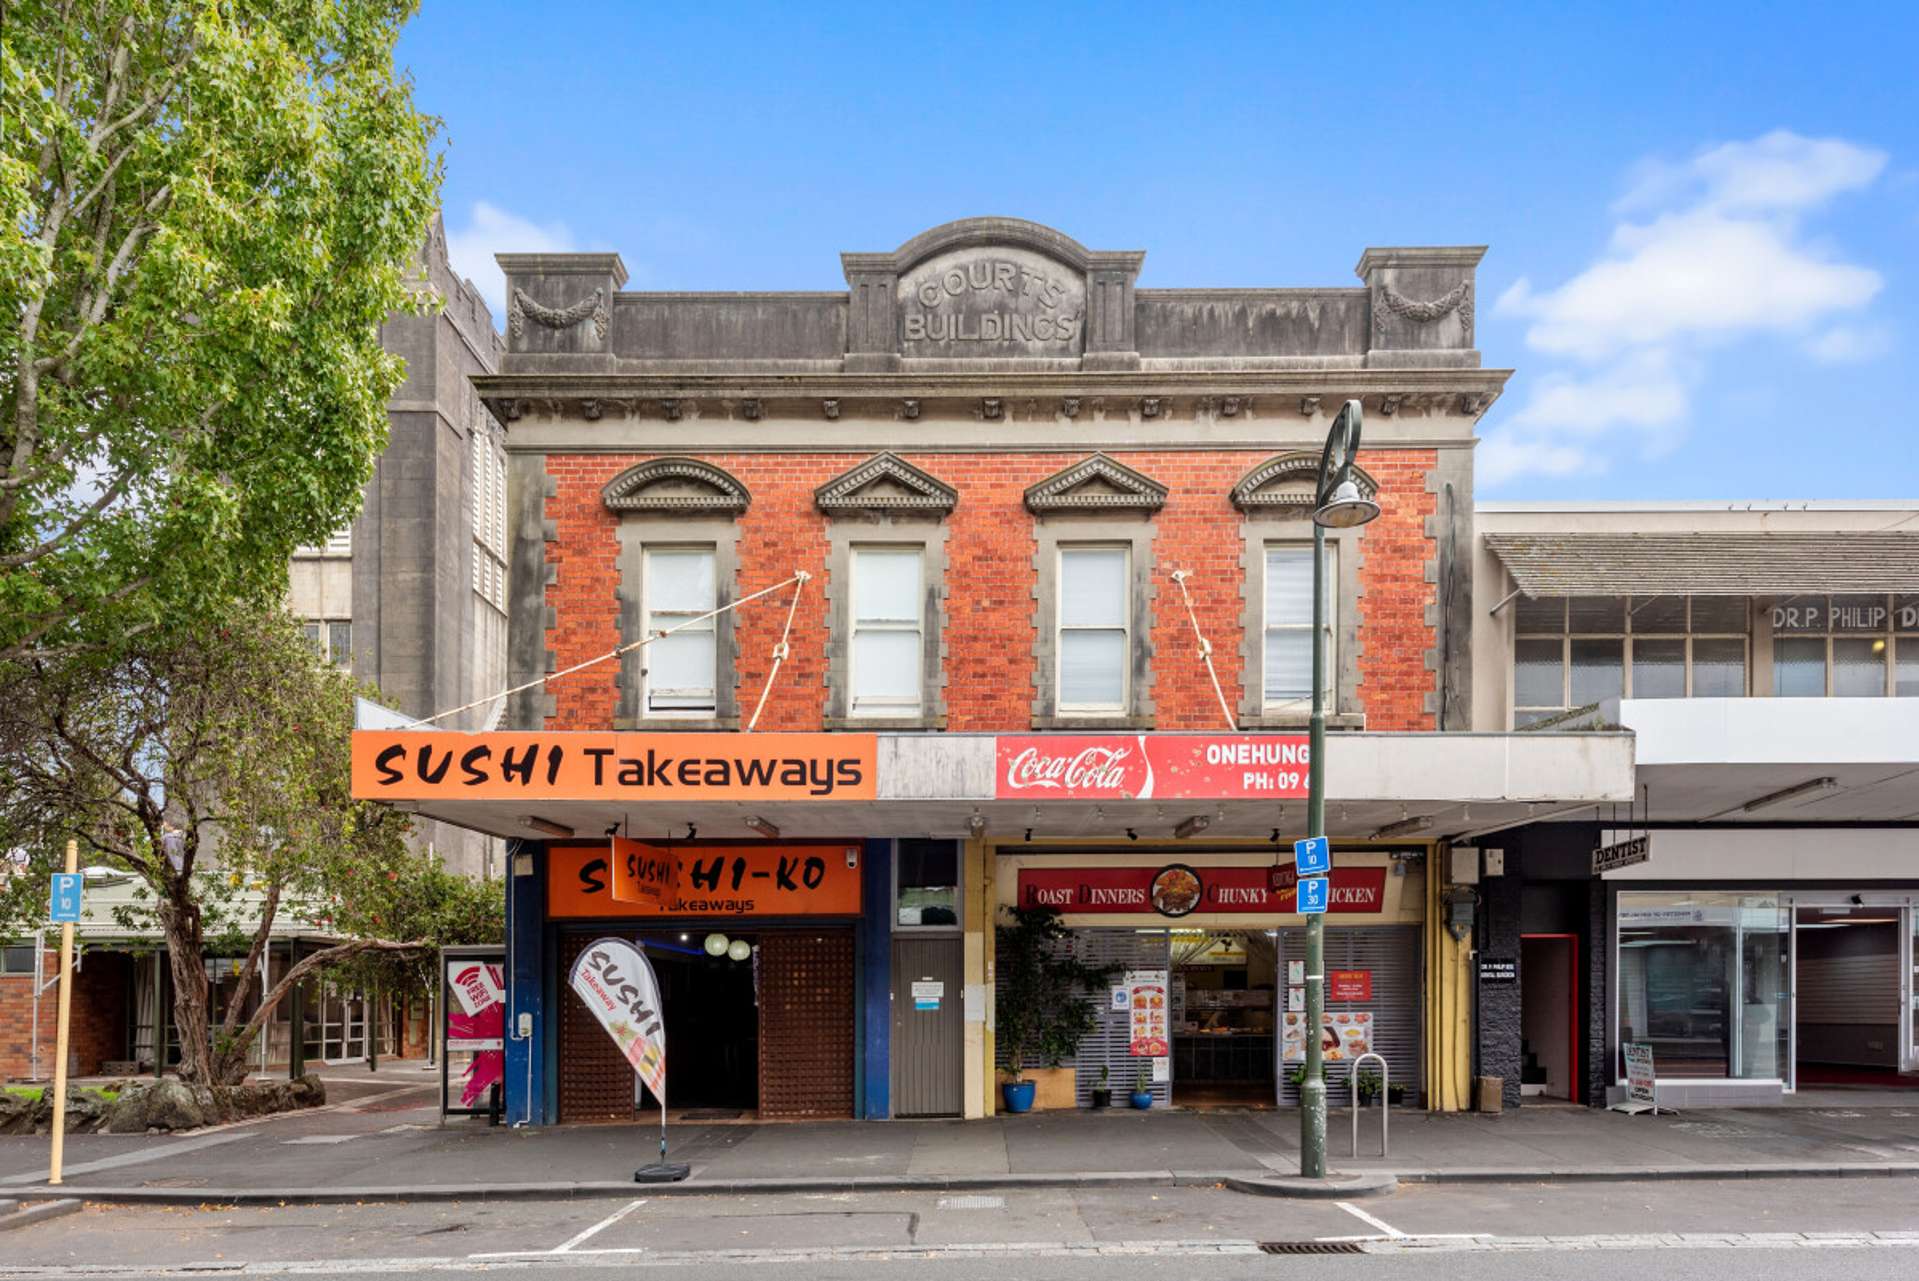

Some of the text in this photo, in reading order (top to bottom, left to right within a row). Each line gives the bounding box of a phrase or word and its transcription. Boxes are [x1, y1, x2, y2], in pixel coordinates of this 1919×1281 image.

[917, 263, 1066, 309] COURTS
[904, 313, 1076, 342] BUILDINGS
[1829, 607, 1886, 628] PHILIP
[1901, 606, 1919, 628] D
[374, 743, 862, 796] SUSHI Takeaways
[1243, 772, 1274, 790] PH:
[1278, 772, 1300, 790] 09
[1305, 841, 1316, 854] P
[1595, 836, 1647, 865] DENTIST
[627, 854, 671, 884] SUSHI
[60, 876, 74, 895] P
[1025, 884, 1145, 905] ROAST DINNERS
[1308, 880, 1319, 893] P
[581, 968, 617, 1012] Takeaway
[587, 951, 661, 1037] SUSHI
